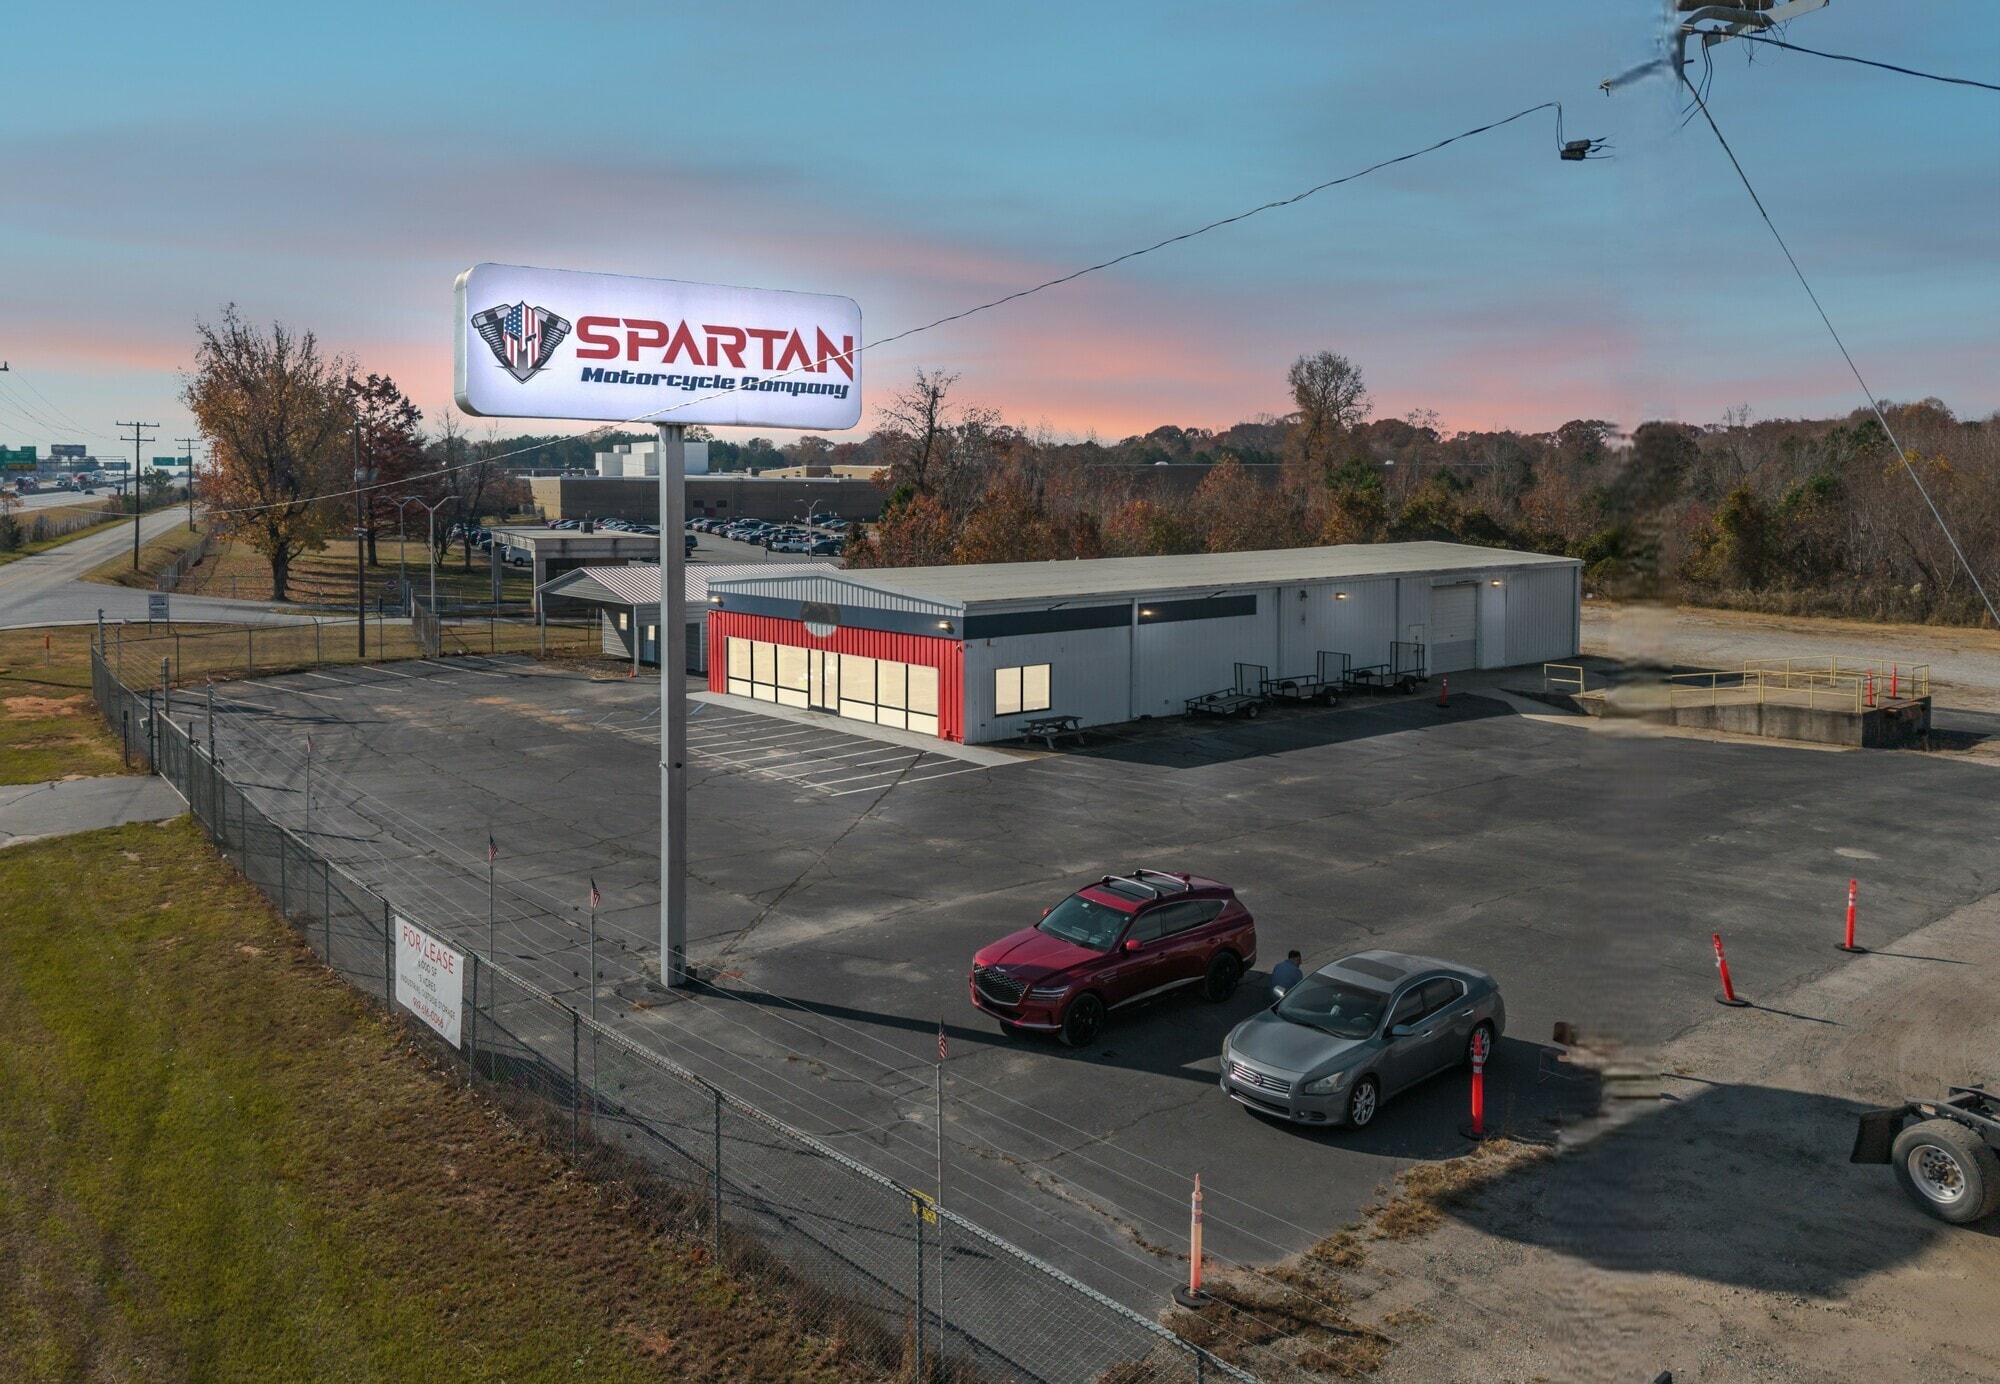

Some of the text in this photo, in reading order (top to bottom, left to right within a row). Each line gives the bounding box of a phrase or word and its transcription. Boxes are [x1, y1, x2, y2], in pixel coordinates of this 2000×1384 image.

[576, 316, 854, 382] SPARTAN
[580, 367, 850, 399] Motorcycle Company
[403, 925, 454, 975] FOR LEASE
[401, 973, 455, 1020] INDUSTRIAL OUTSIDE STORAGE
[423, 978, 436, 992] ACRES
